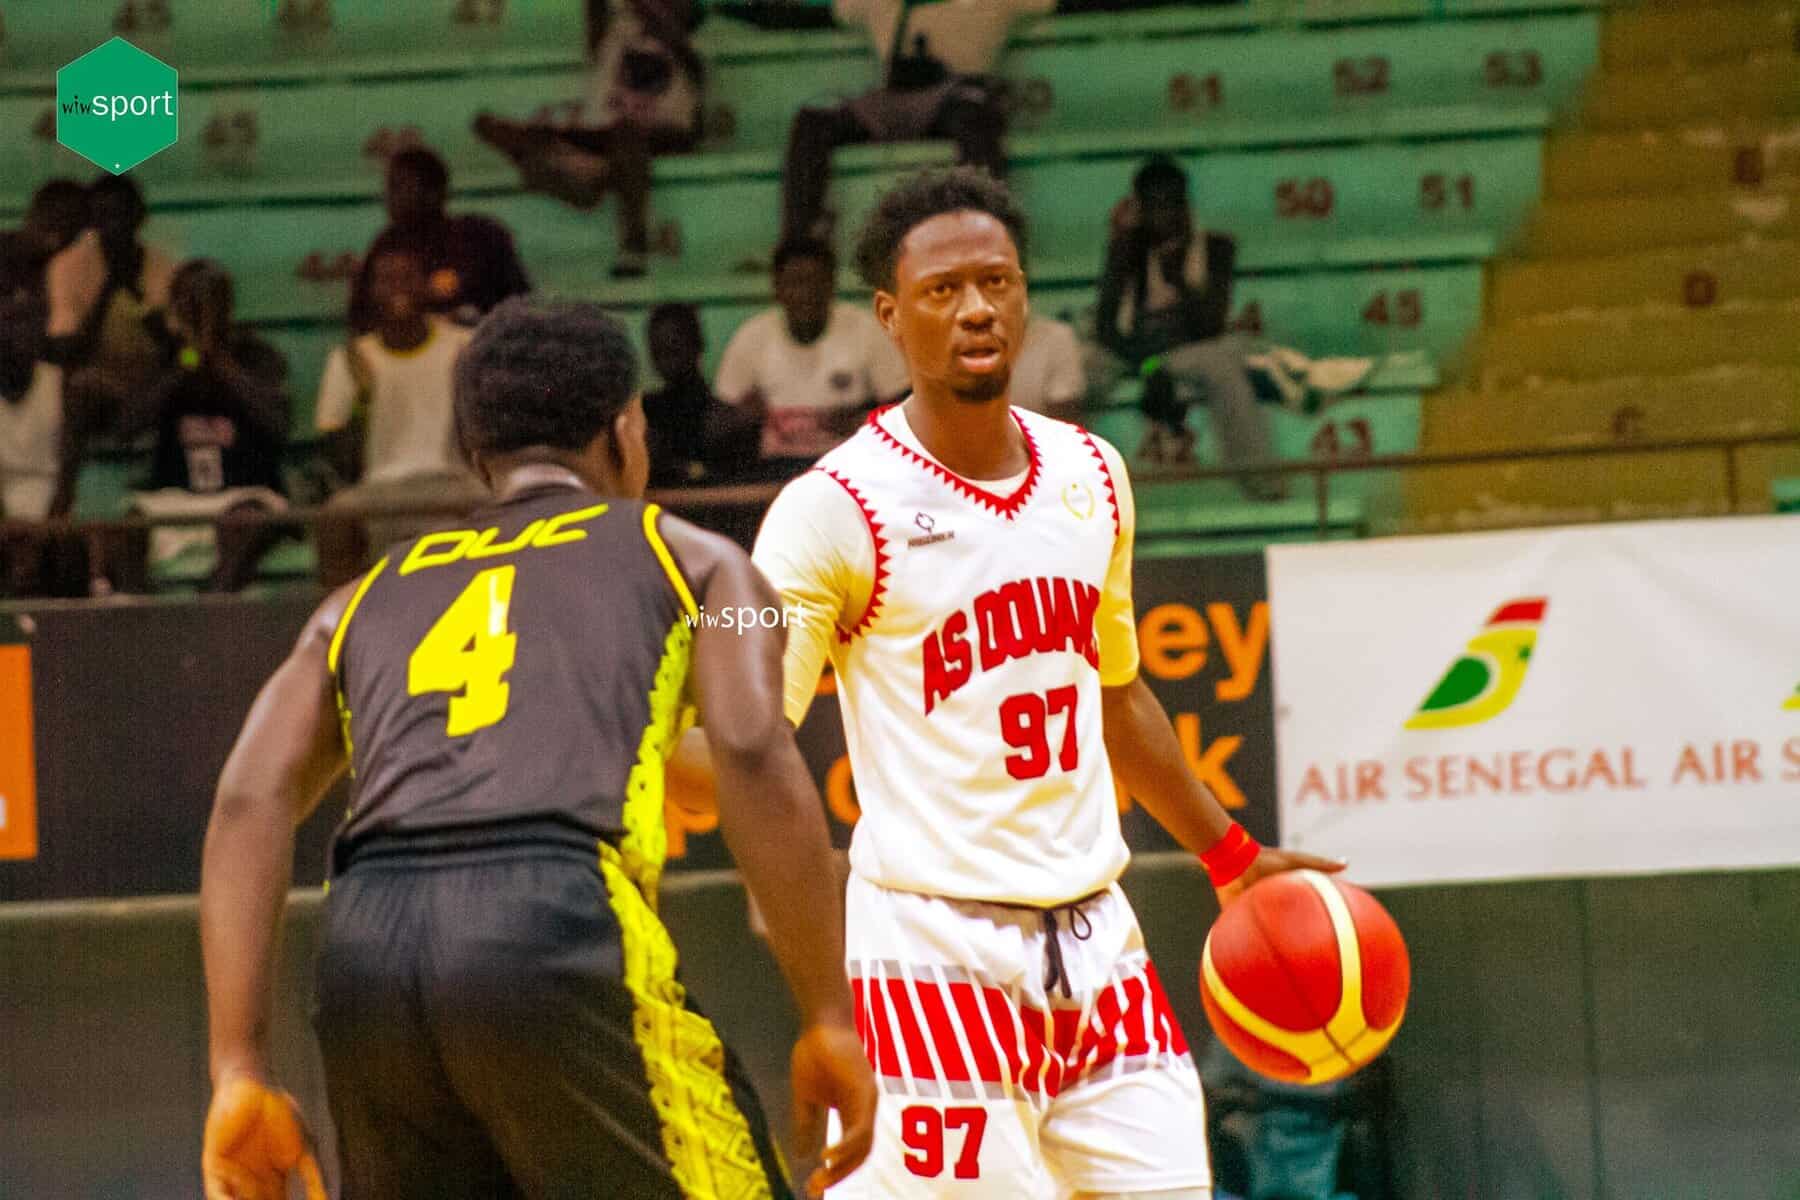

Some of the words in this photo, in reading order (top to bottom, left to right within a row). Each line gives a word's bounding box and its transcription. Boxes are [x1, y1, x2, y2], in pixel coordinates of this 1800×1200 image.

[1333, 56, 1389, 97] 52
[1484, 52, 1541, 88] 53
[1275, 178, 1334, 218] 50
[1420, 174, 1475, 210] 51
[399, 503, 609, 576] DUC
[407, 564, 517, 738] 4
[922, 609, 973, 717] AS
[999, 684, 1079, 780] 97
[1295, 758, 1389, 804] AIR
[1403, 747, 1646, 800] SENEGAL
[1672, 739, 1763, 785] AIR
[901, 1104, 988, 1180] 97
